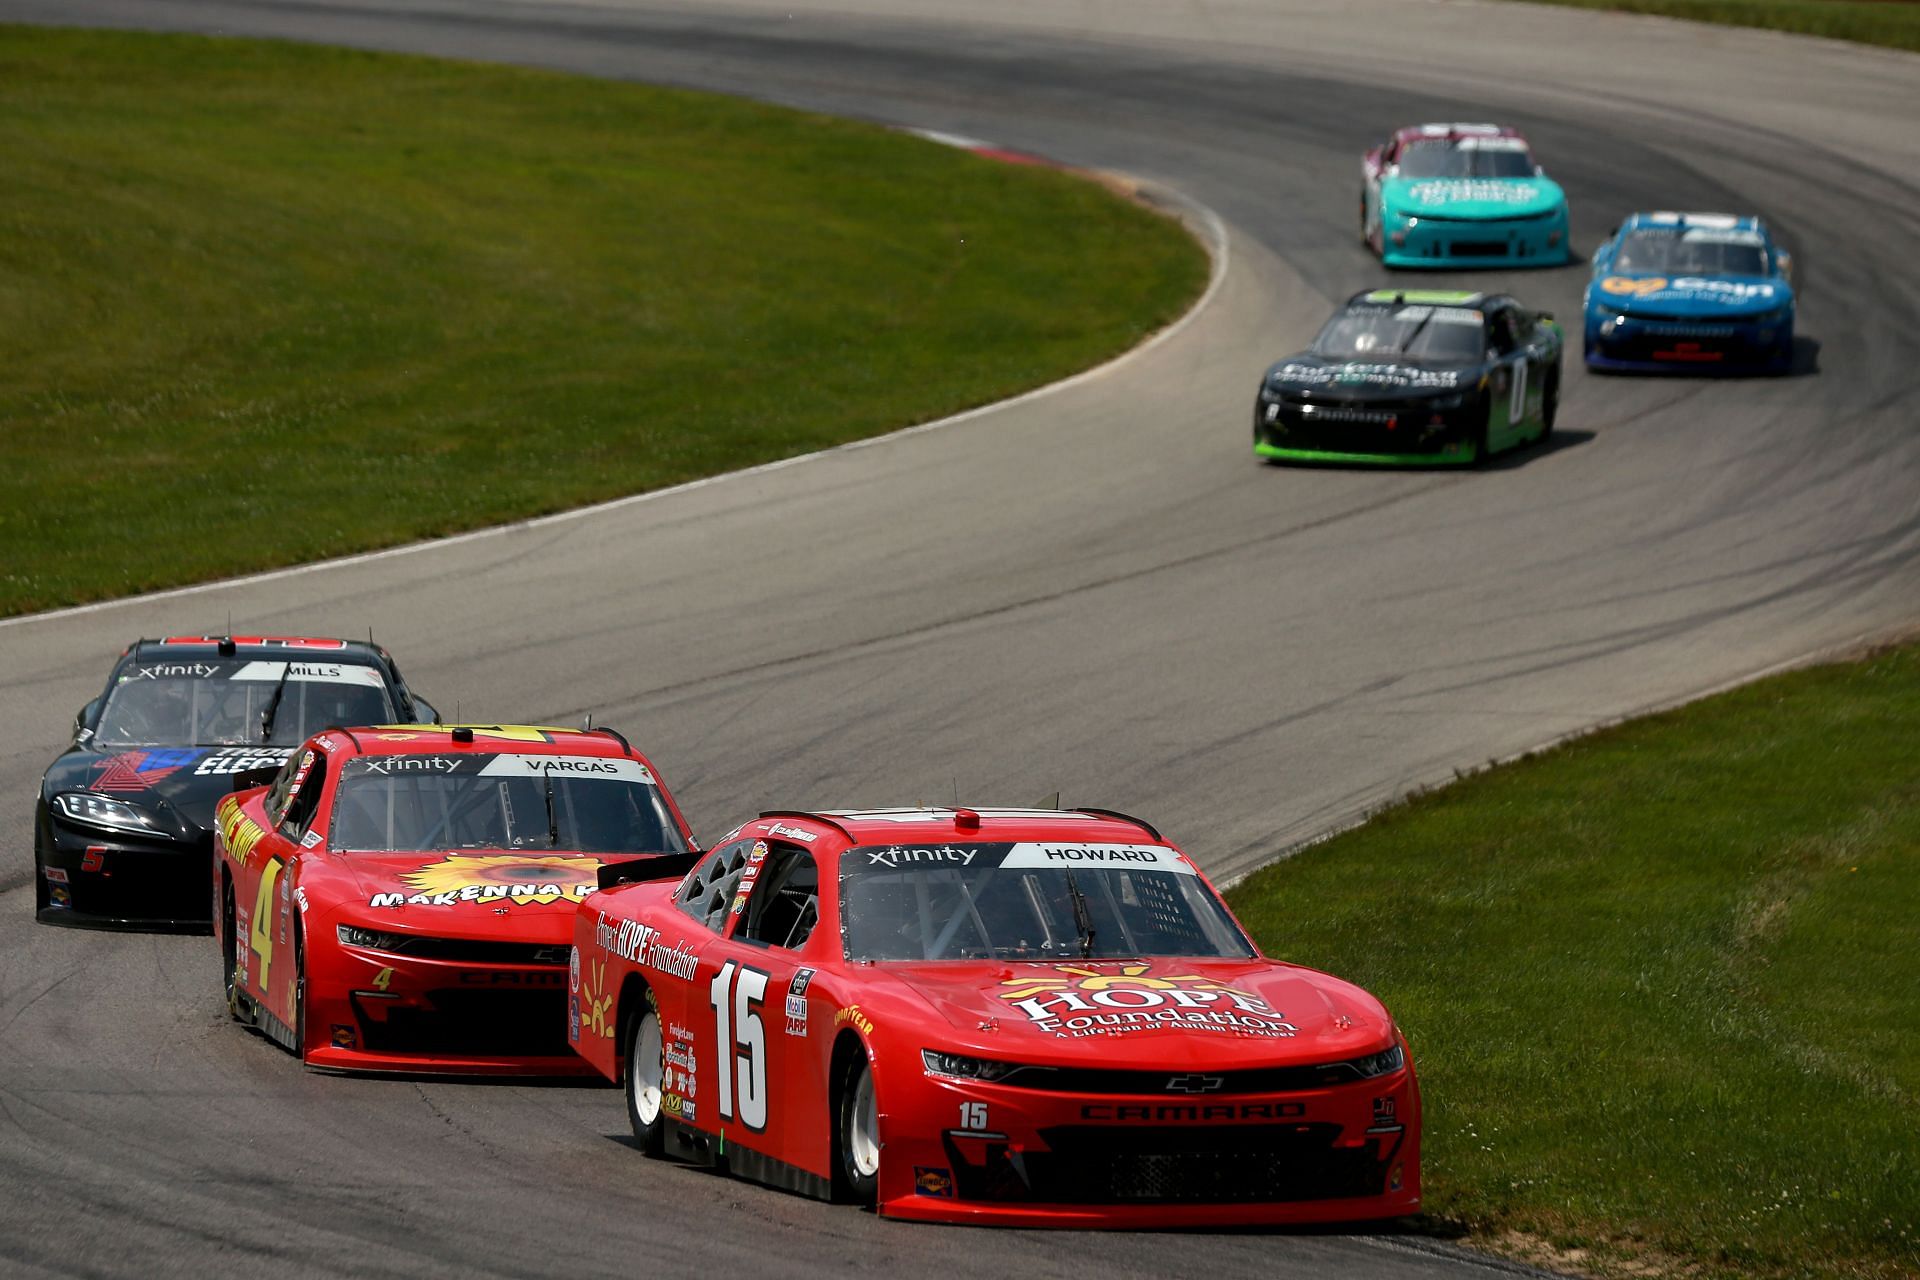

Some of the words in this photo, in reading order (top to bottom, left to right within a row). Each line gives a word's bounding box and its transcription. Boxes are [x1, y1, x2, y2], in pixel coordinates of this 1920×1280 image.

[138, 663, 220, 680] xfinity
[288, 665, 341, 677] MILLS
[366, 756, 463, 774] xfinity
[526, 760, 618, 774] VARGAS
[81, 845, 108, 873] 5
[867, 846, 978, 867] xfinity
[1045, 848, 1157, 863] HOWARD
[251, 855, 284, 994] 4
[597, 911, 620, 962] Project
[617, 918, 654, 964] HOPE
[646, 932, 699, 981] Foundation
[372, 967, 394, 990] 4
[1012, 989, 1283, 1022] HOPE
[786, 1017, 806, 1034] ARP
[1032, 1009, 1299, 1031] Foundation
[1147, 1021, 1162, 1030] of
[1170, 1021, 1226, 1033] Autism
[711, 960, 770, 1132] 15
[960, 1102, 987, 1129] 15
[1081, 1103, 1306, 1120] CAMARO
[917, 1176, 951, 1187] SUNOCO
